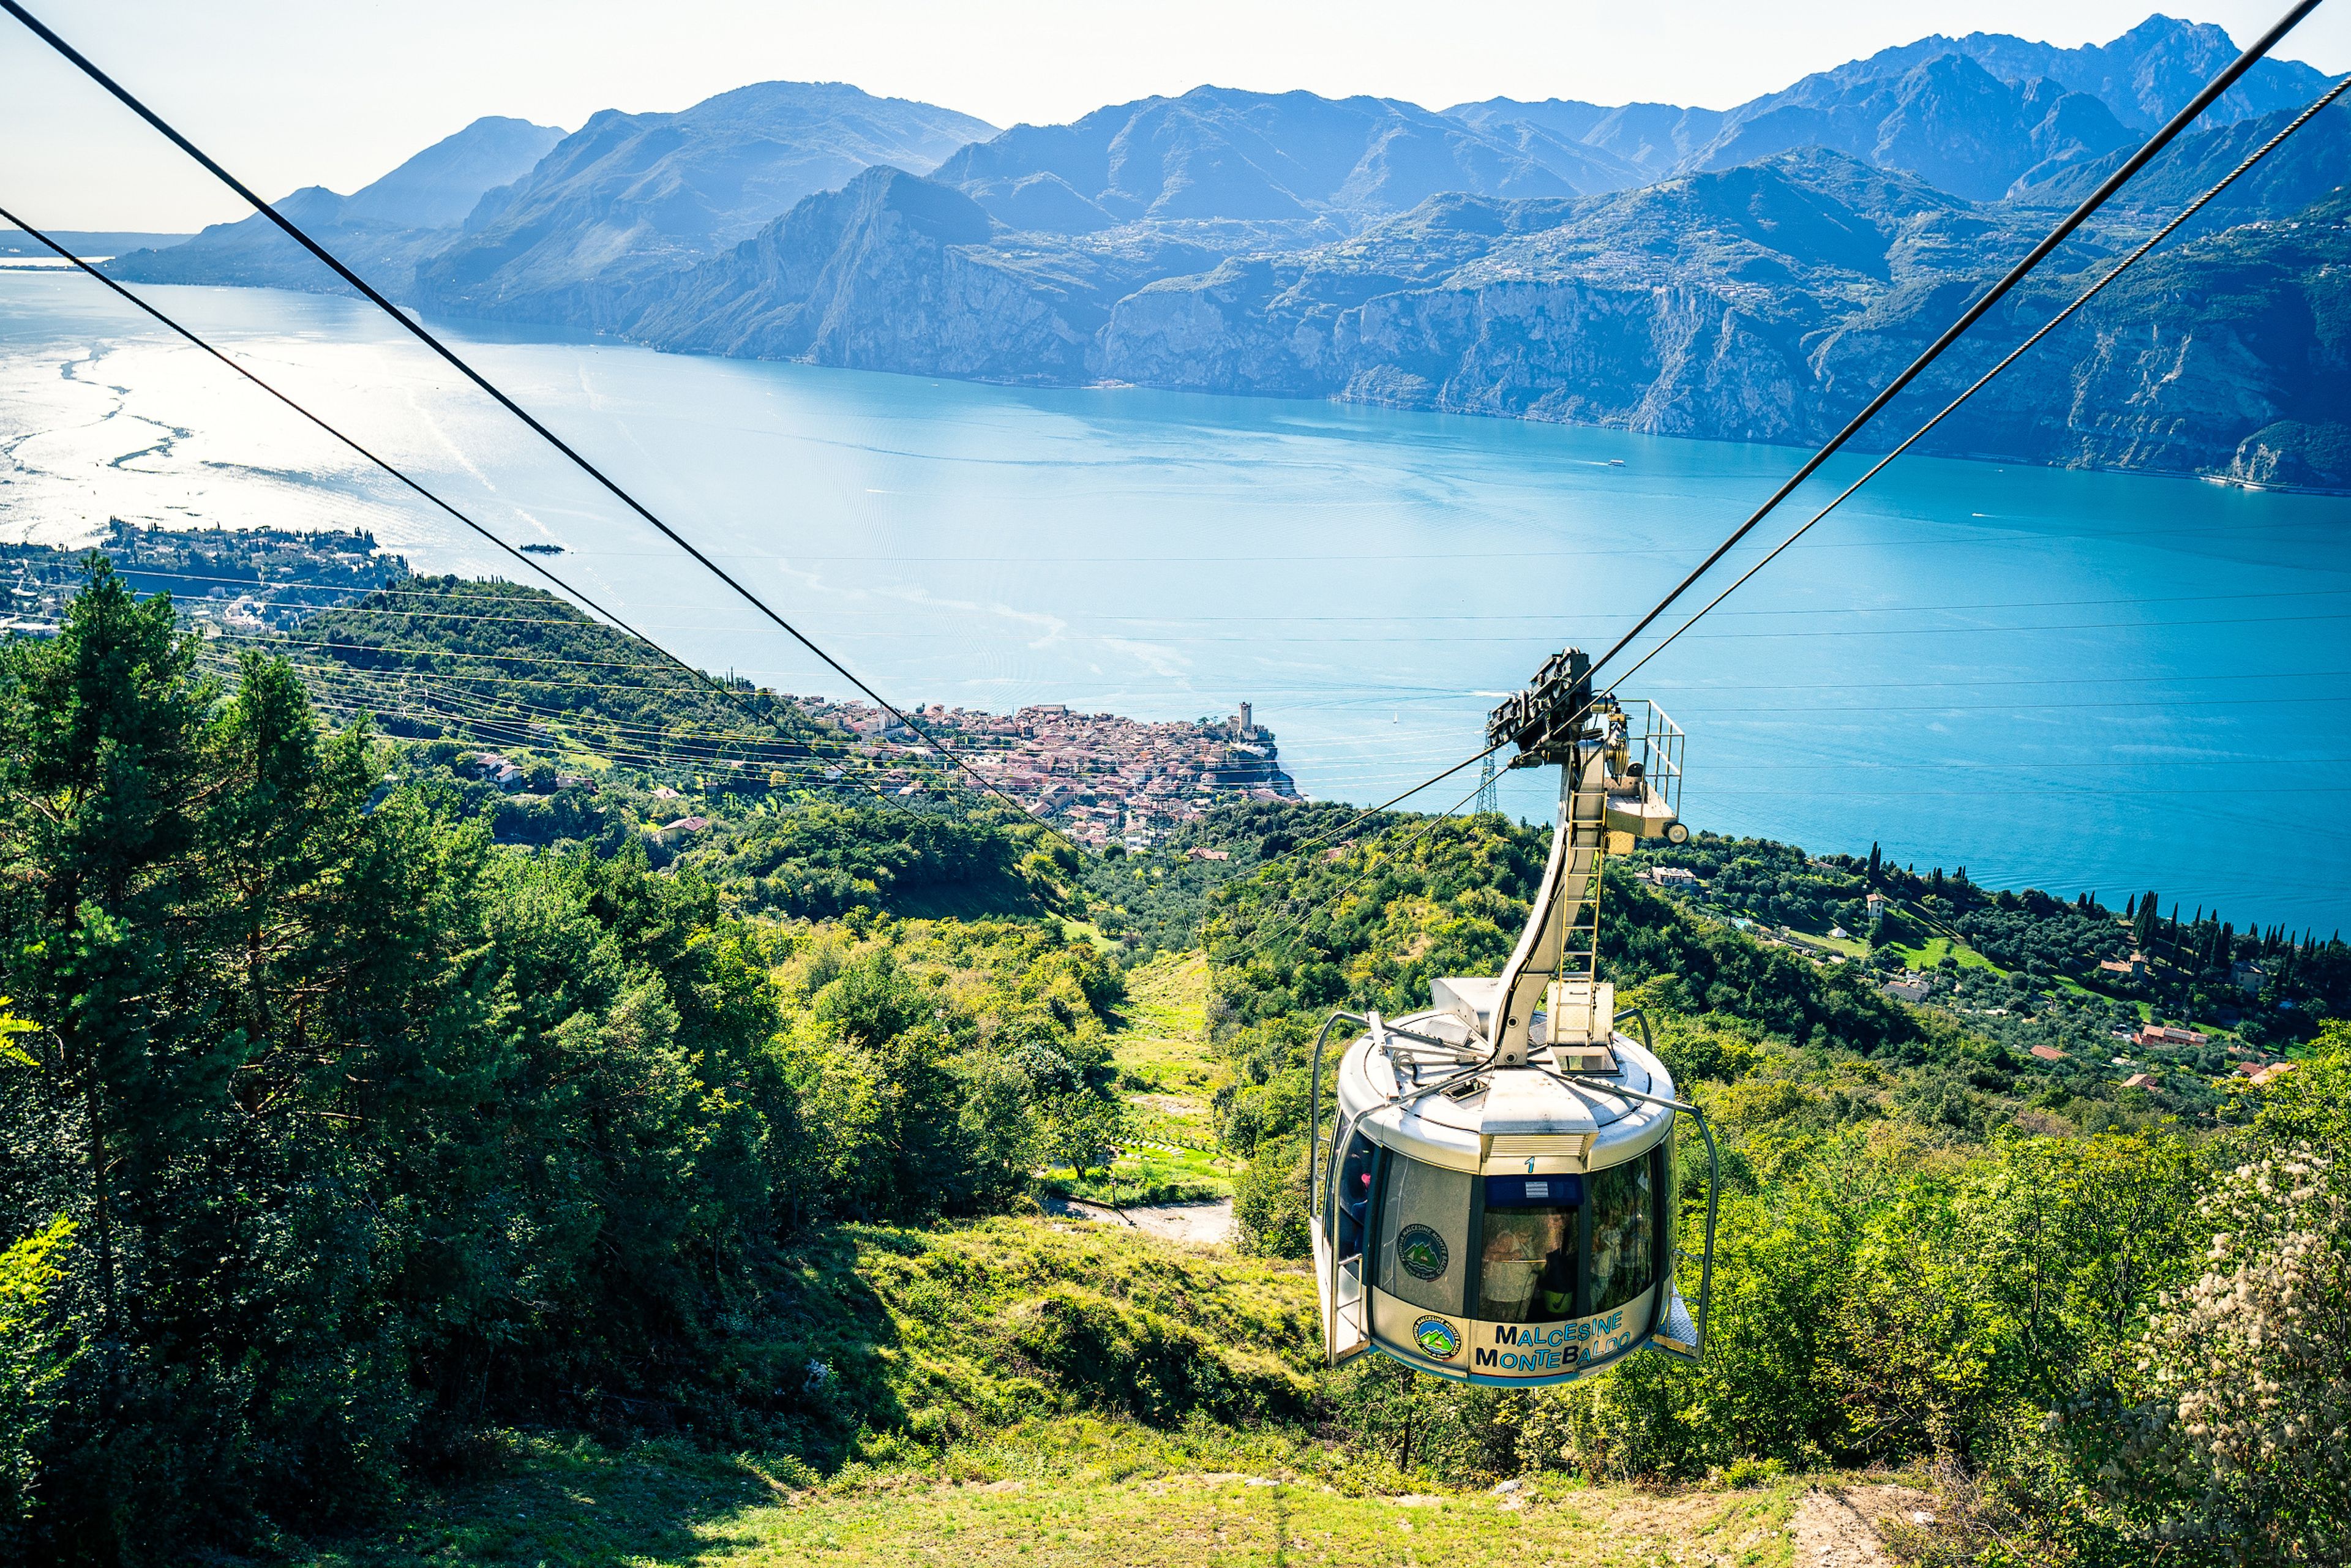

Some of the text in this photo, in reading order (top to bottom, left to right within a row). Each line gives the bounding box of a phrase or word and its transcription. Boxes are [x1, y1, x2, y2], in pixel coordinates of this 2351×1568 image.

[1524, 1156, 1535, 1173] 1
[1403, 1225, 1432, 1237] MALCESINE
[1431, 1232, 1447, 1254] MONTE
[1436, 1255, 1448, 1275] BALDO
[1417, 1316, 1445, 1324] MALCESINE
[1444, 1322, 1460, 1340] MONTE
[1495, 1311, 1623, 1347] MALCESINE
[1450, 1340, 1461, 1356] BALDO
